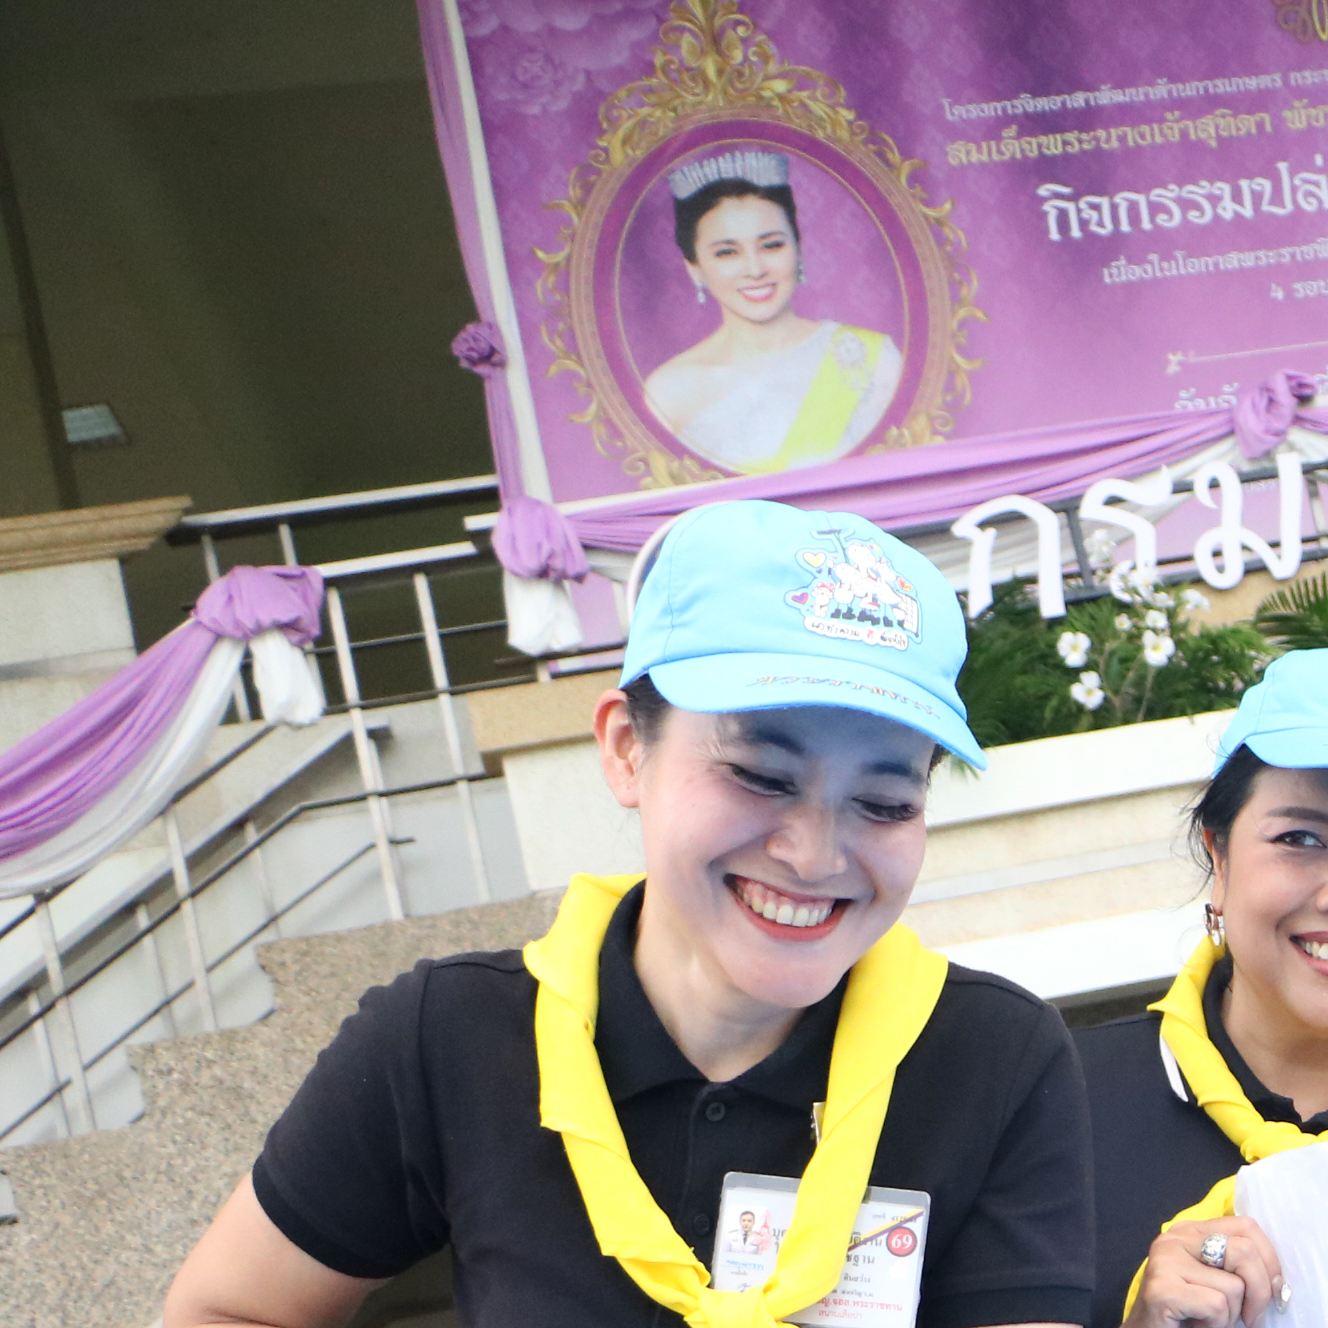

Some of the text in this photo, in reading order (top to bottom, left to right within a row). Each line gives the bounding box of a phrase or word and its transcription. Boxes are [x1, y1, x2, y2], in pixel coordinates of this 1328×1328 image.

[946, 109, 1273, 166] สมเด็จพระนางเจ้าสุทิดา
[1270, 283, 1285, 301] 4
[891, 1233, 913, 1250] 69
